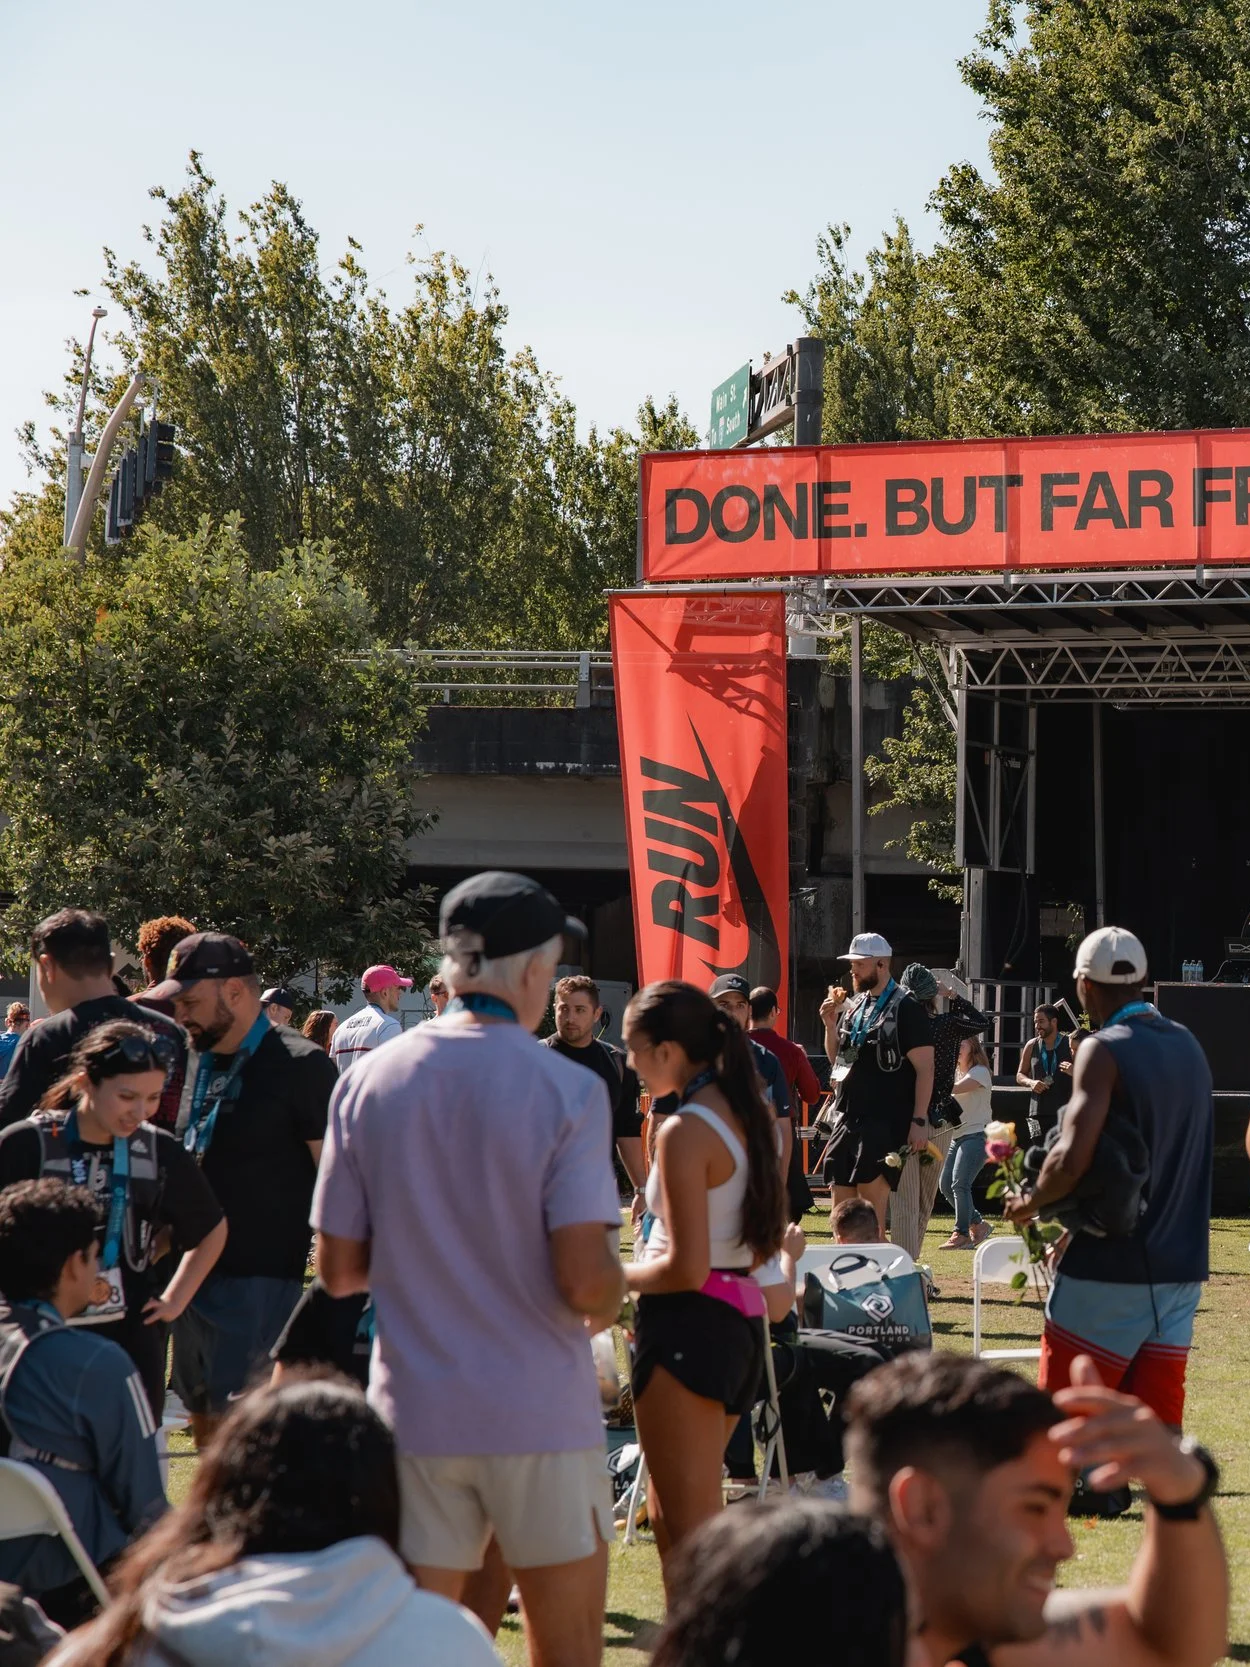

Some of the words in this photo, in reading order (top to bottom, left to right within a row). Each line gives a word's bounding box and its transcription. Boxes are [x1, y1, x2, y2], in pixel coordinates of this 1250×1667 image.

[726, 410, 740, 435] South
[666, 482, 866, 544] DONE.
[886, 475, 1022, 535] BUT
[1042, 471, 1172, 529] FAR
[641, 756, 720, 951] RUN
[848, 1325, 909, 1335] PORTLAND
